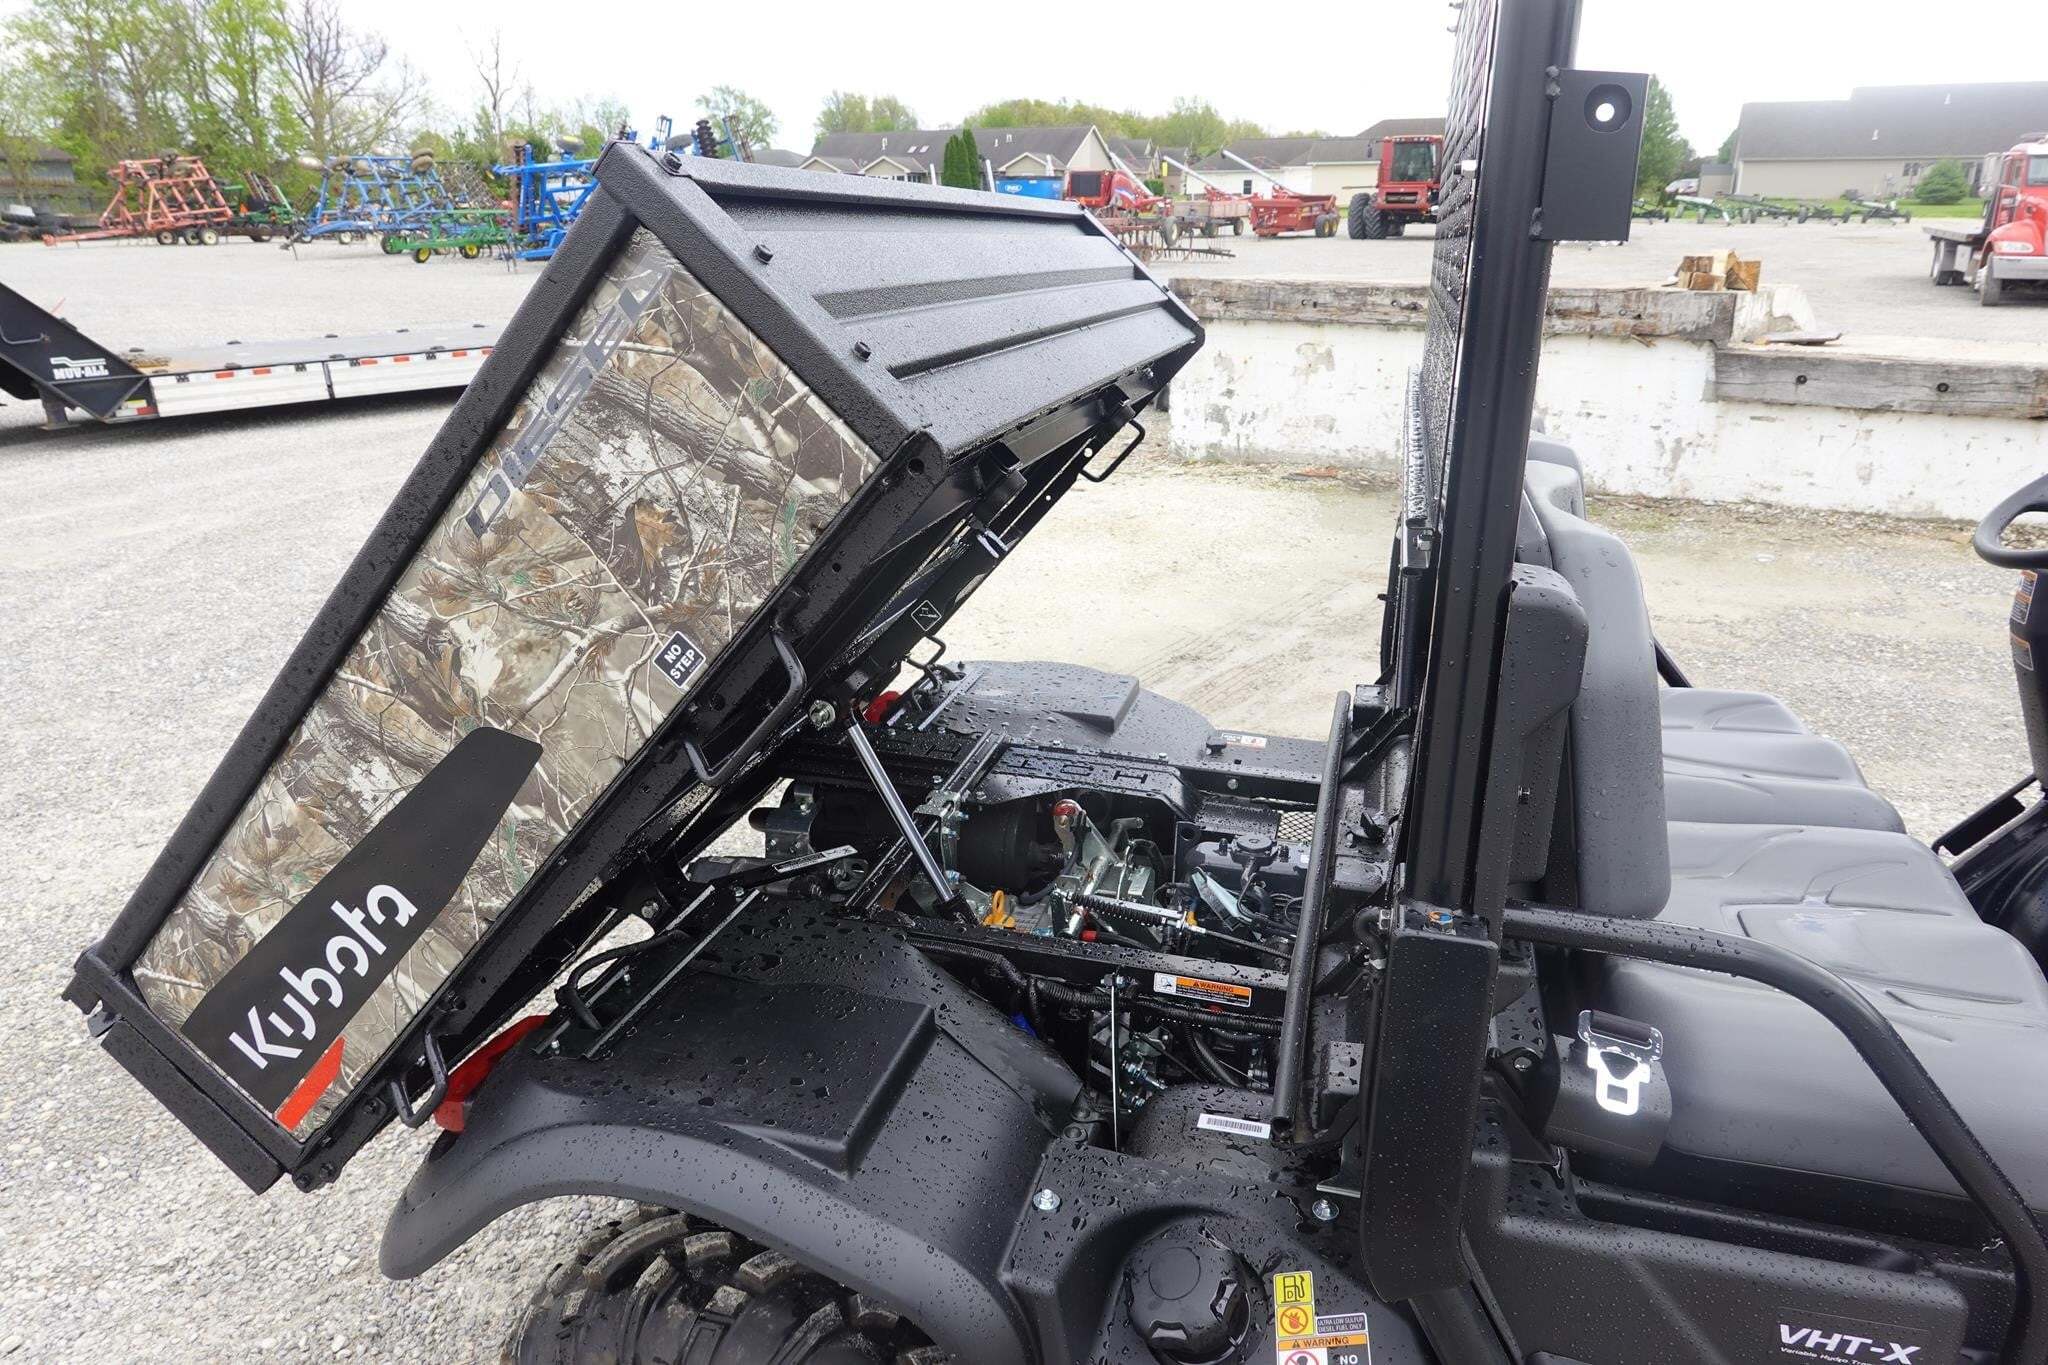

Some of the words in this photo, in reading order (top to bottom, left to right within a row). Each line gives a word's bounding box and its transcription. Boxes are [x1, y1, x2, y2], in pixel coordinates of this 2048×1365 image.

[465, 262, 672, 538] DIESEL
[664, 644, 682, 664] NO
[670, 649, 695, 680] STEP
[228, 883, 418, 1070] Kubota
[1199, 981, 1234, 993] WARNING
[1304, 1337, 1349, 1347] WARNING
[1780, 1323, 1921, 1365] VHT-X
[1340, 1354, 1358, 1365] NO
[1780, 1346, 1818, 1358] Variable
[1820, 1354, 1849, 1364] Hydro
